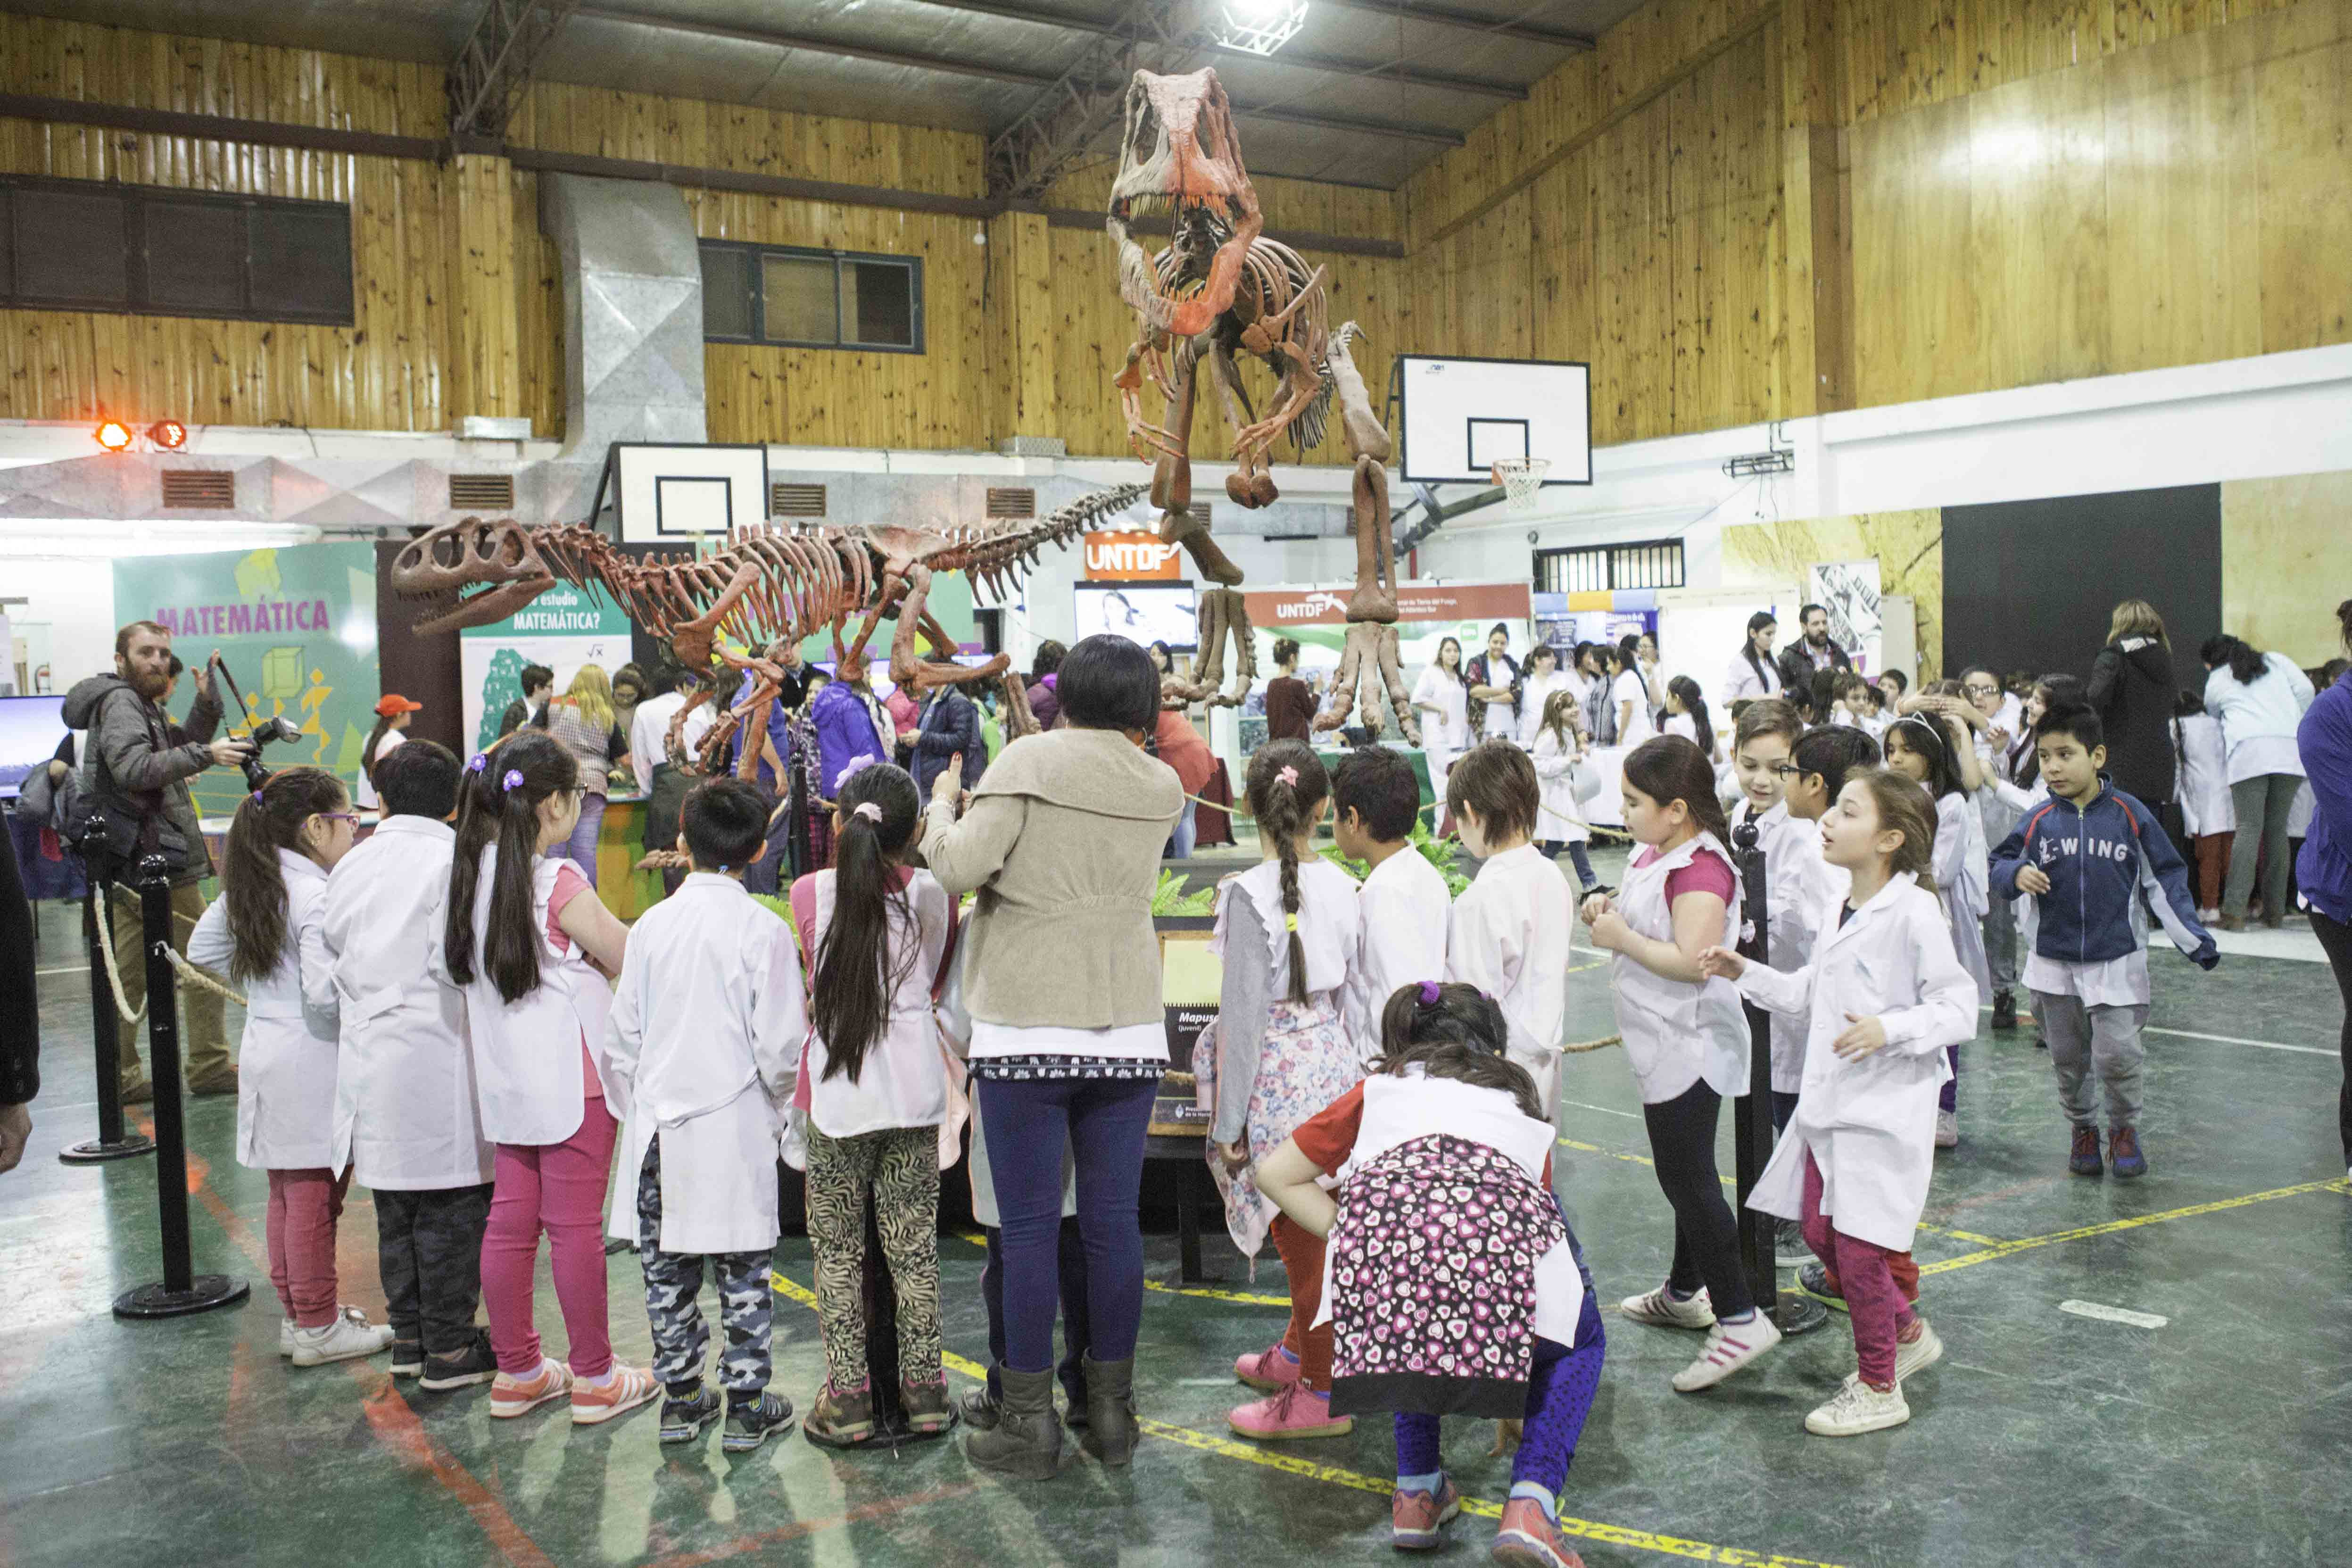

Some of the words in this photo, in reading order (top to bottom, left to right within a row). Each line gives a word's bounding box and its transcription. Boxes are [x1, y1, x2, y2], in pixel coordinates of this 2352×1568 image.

[1087, 543, 1169, 571] UNTDF
[541, 590, 578, 606] estudio
[157, 595, 330, 637] MATEMÁTICA
[513, 609, 600, 630] MATEMÁTICA?
[1276, 603, 1324, 619] UNTDF
[1178, 1025, 1201, 1033] (juvenil)
